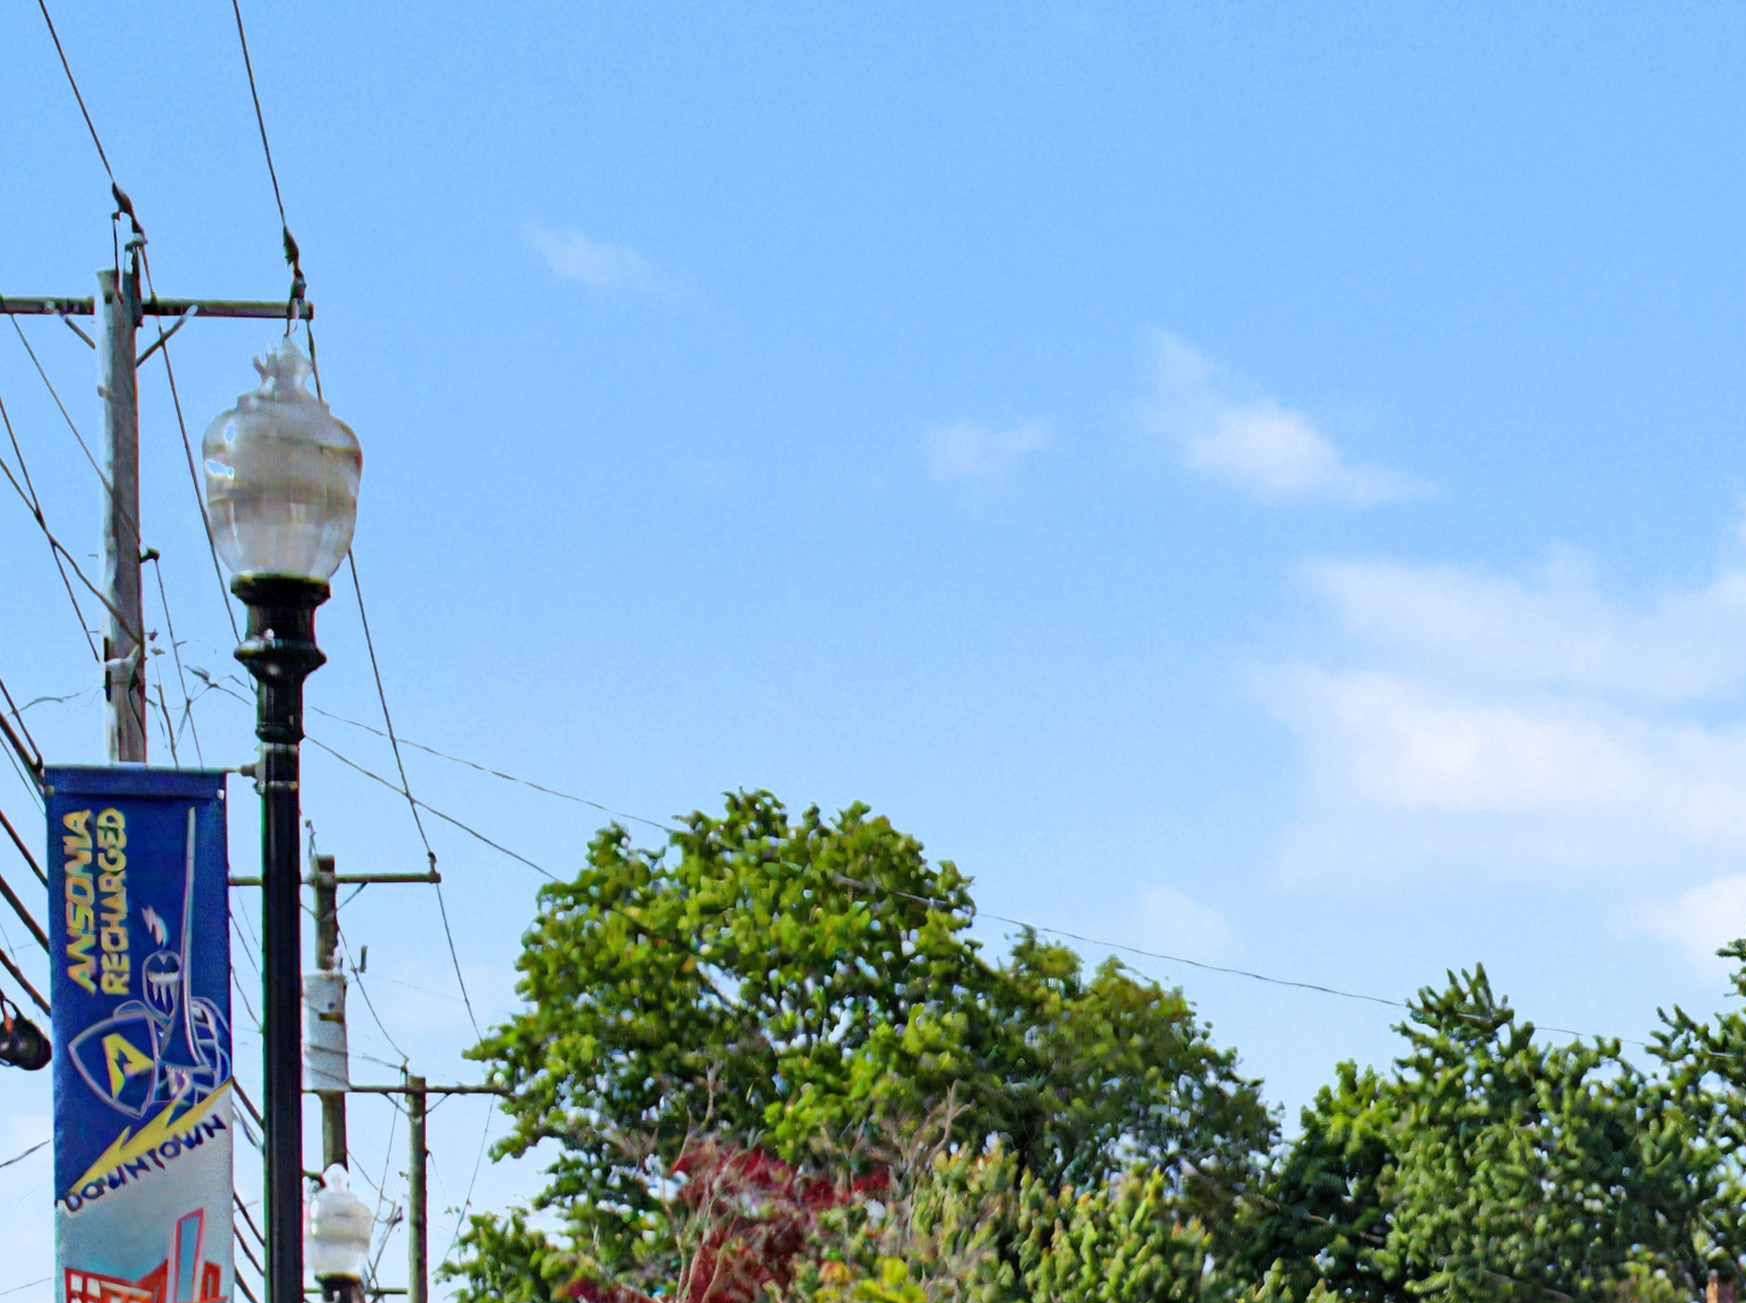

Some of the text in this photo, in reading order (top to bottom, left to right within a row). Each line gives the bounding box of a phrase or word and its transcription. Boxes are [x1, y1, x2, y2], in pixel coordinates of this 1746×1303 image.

[63, 809, 96, 997] ANSONIA
[97, 807, 130, 995] RECHARGED
[64, 1113, 227, 1212] DOWNTOWN
